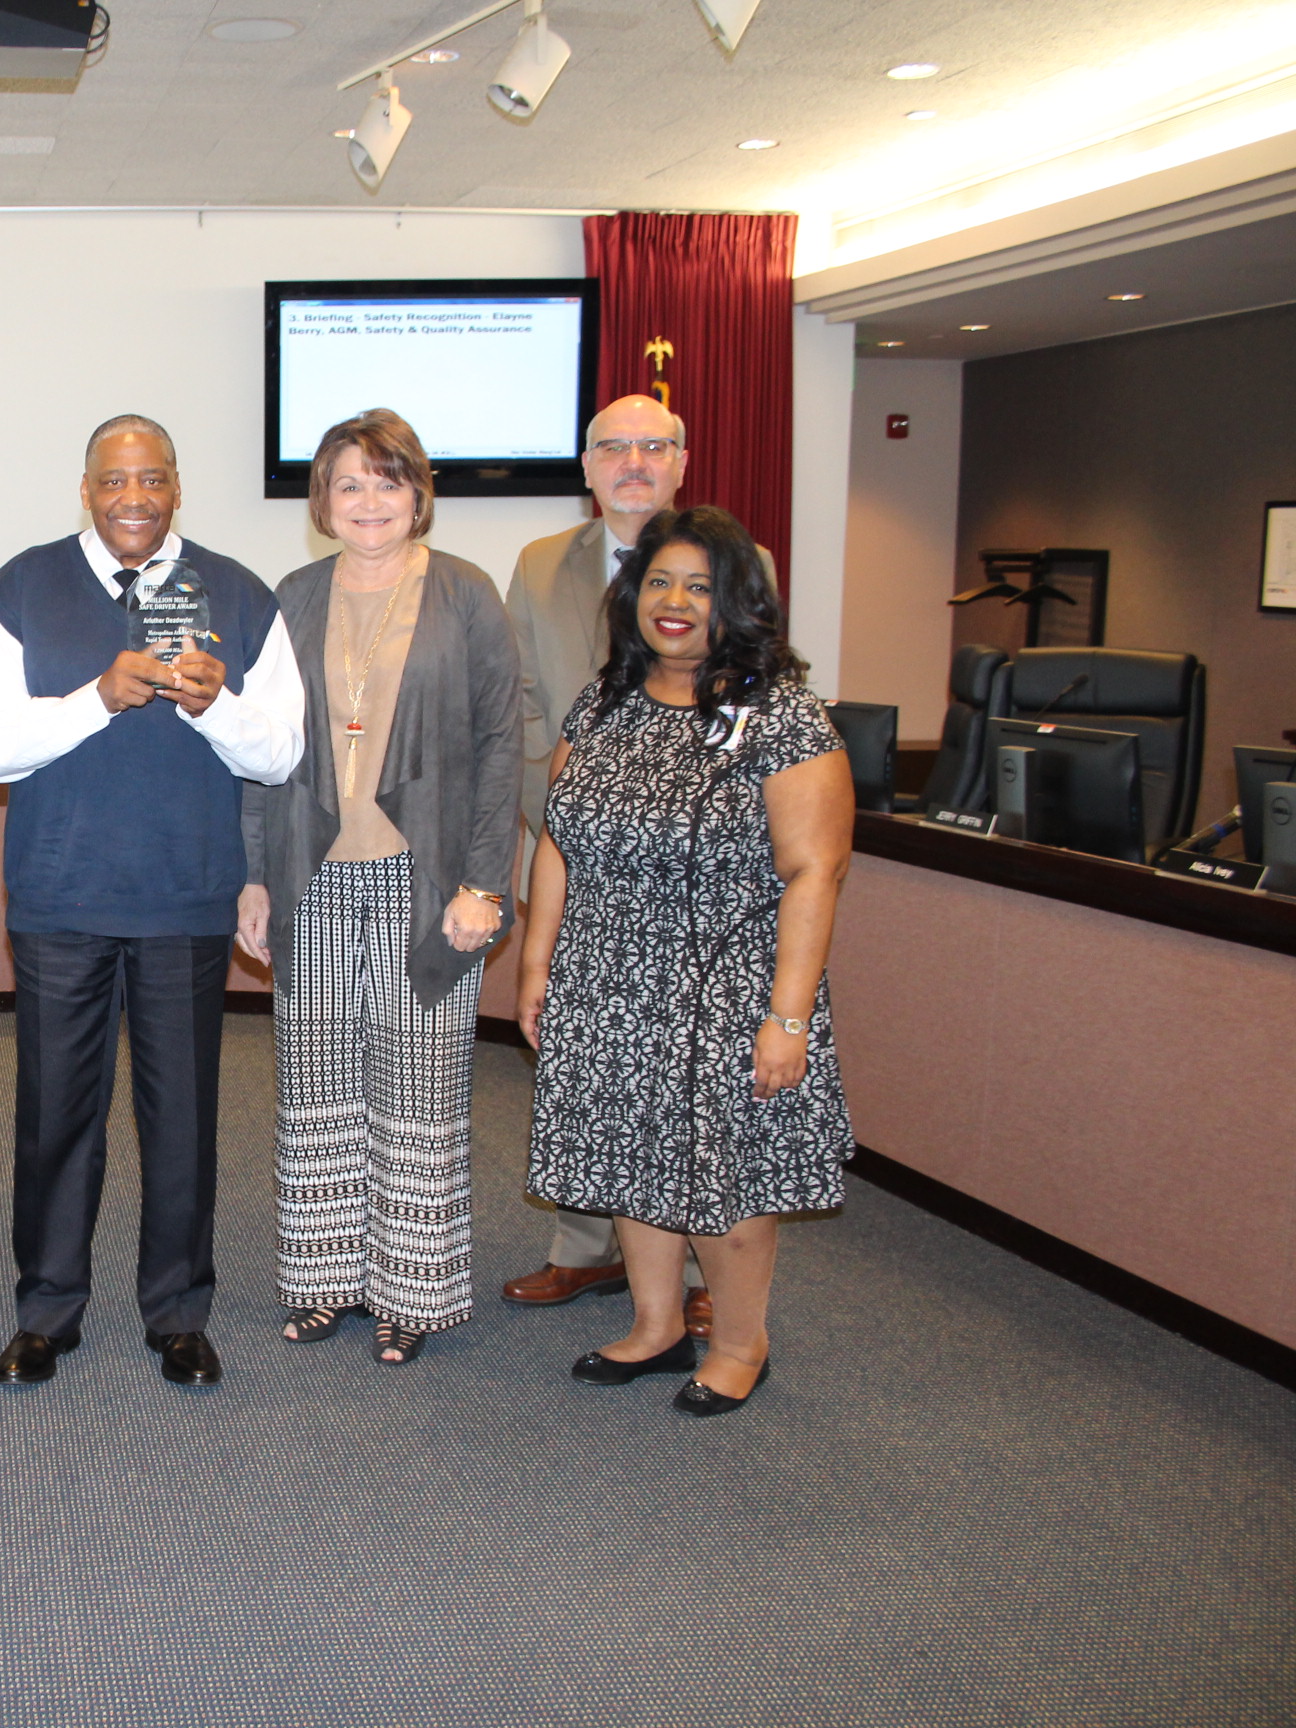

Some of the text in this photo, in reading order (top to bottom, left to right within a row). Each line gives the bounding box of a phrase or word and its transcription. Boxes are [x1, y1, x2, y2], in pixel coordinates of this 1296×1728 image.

[304, 313, 353, 323] Briefing
[364, 312, 402, 322] Safety
[406, 312, 482, 322] Recognition
[492, 312, 533, 322] Elayne
[288, 325, 532, 336] Berry, AGM, Safety & Quality Assurance
[935, 810, 983, 828] JERRY GRIFFIN
[1189, 861, 1235, 879] Alicia Ivey
